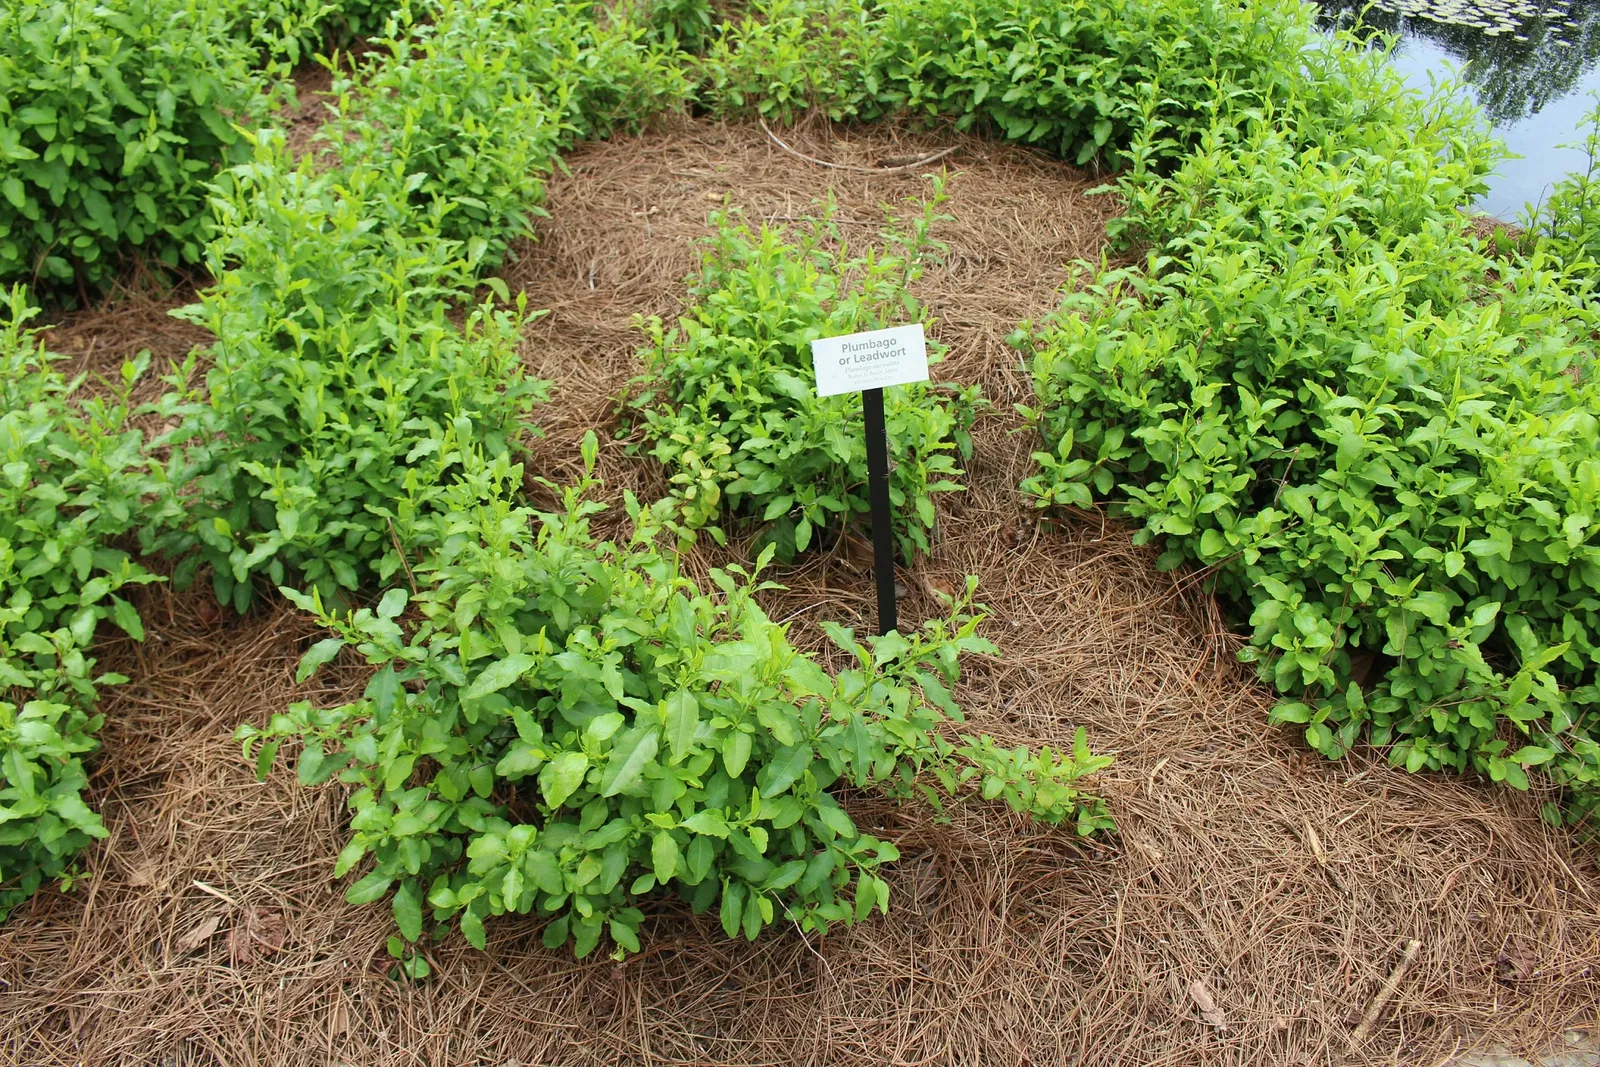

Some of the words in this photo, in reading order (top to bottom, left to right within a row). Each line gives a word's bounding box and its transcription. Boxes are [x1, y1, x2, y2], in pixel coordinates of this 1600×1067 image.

[841, 338, 897, 353] Plumbago
[838, 356, 851, 366] or
[853, 347, 907, 363] Leadwort
